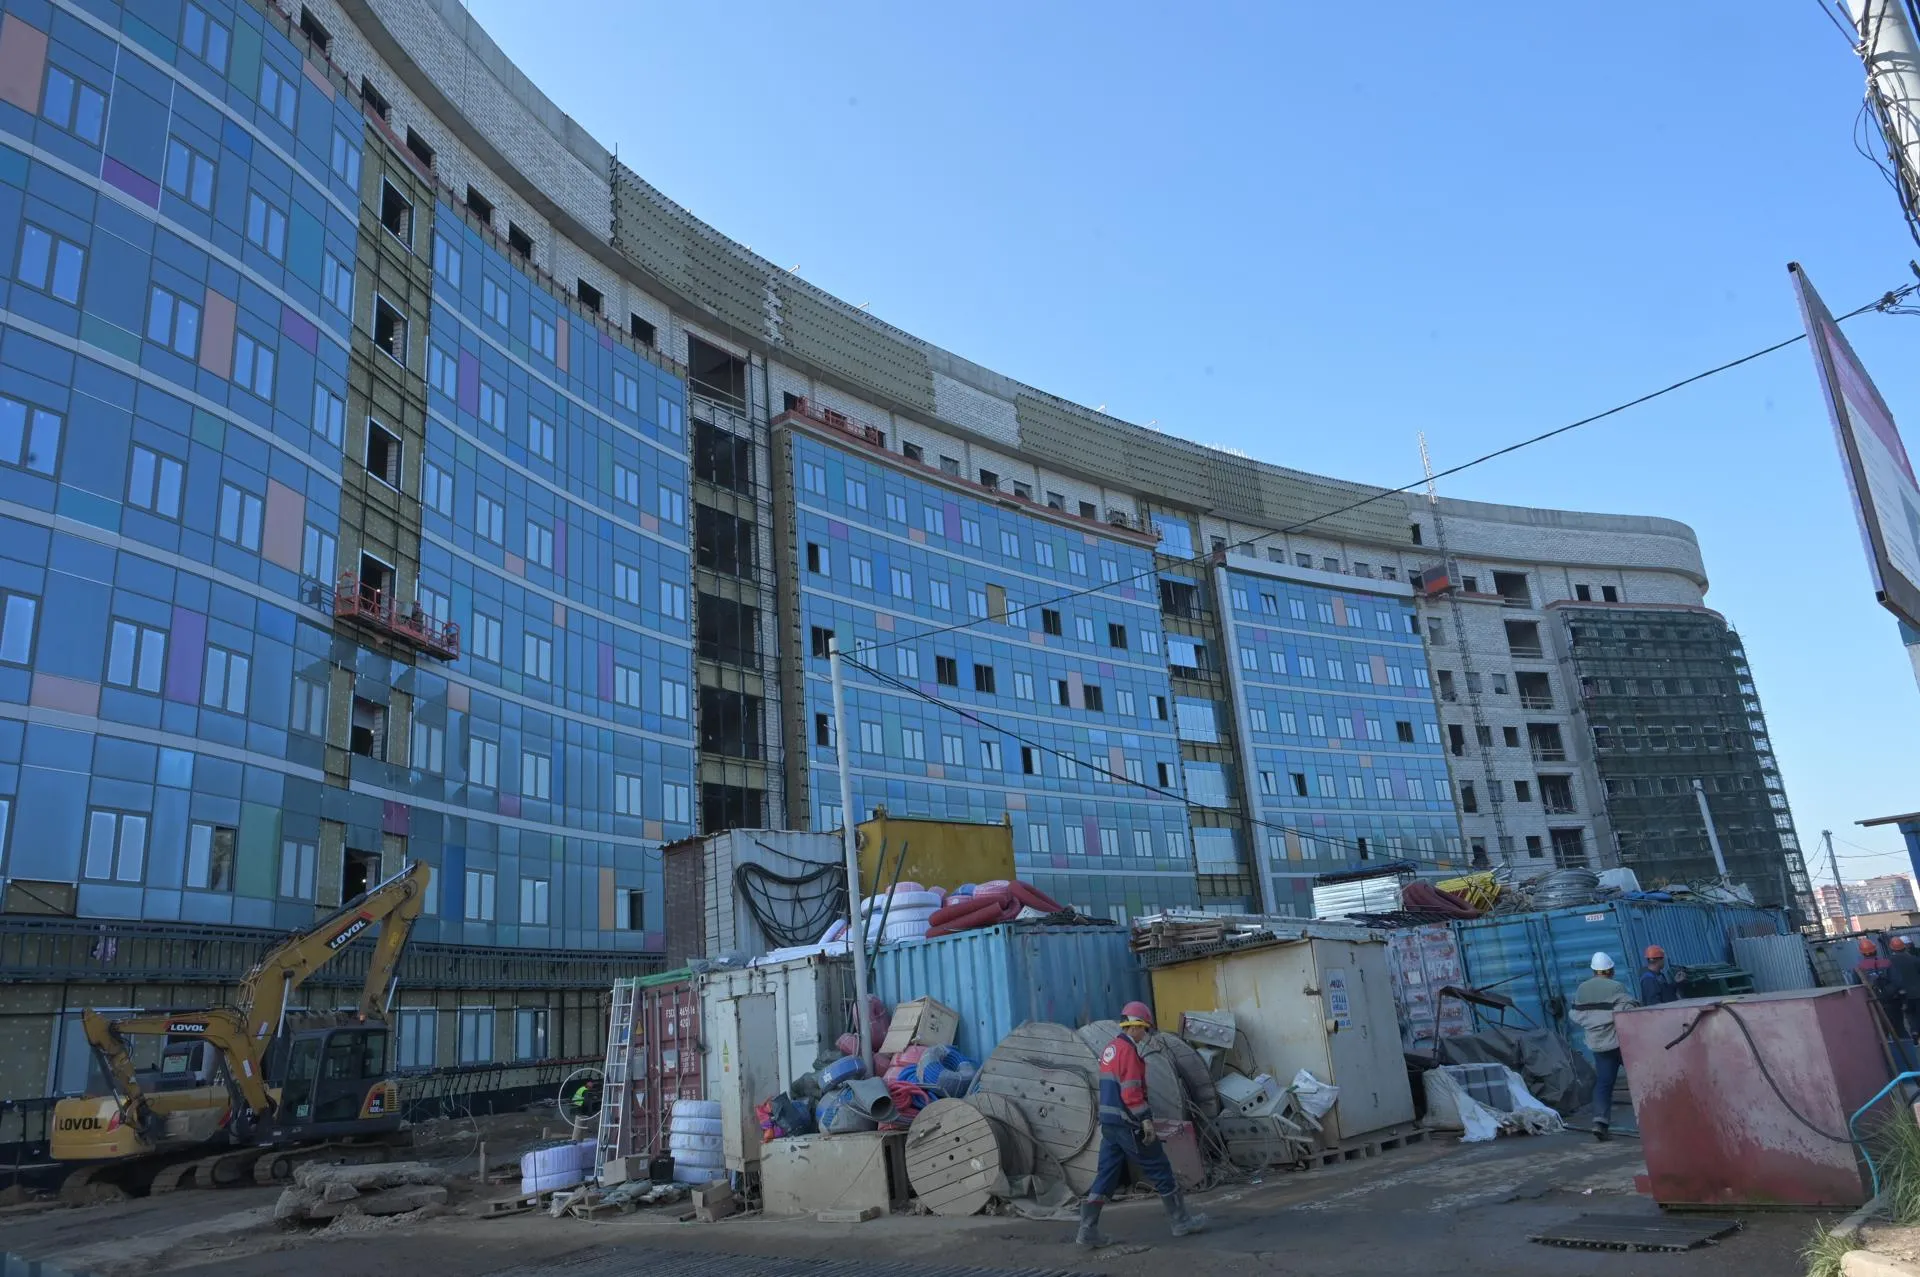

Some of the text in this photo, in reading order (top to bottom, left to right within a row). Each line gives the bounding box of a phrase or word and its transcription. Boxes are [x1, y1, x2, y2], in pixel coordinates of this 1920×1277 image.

[331, 920, 366, 949] LOVOL
[170, 1023, 205, 1032] LOVOL
[59, 1117, 102, 1131] LOVOL
